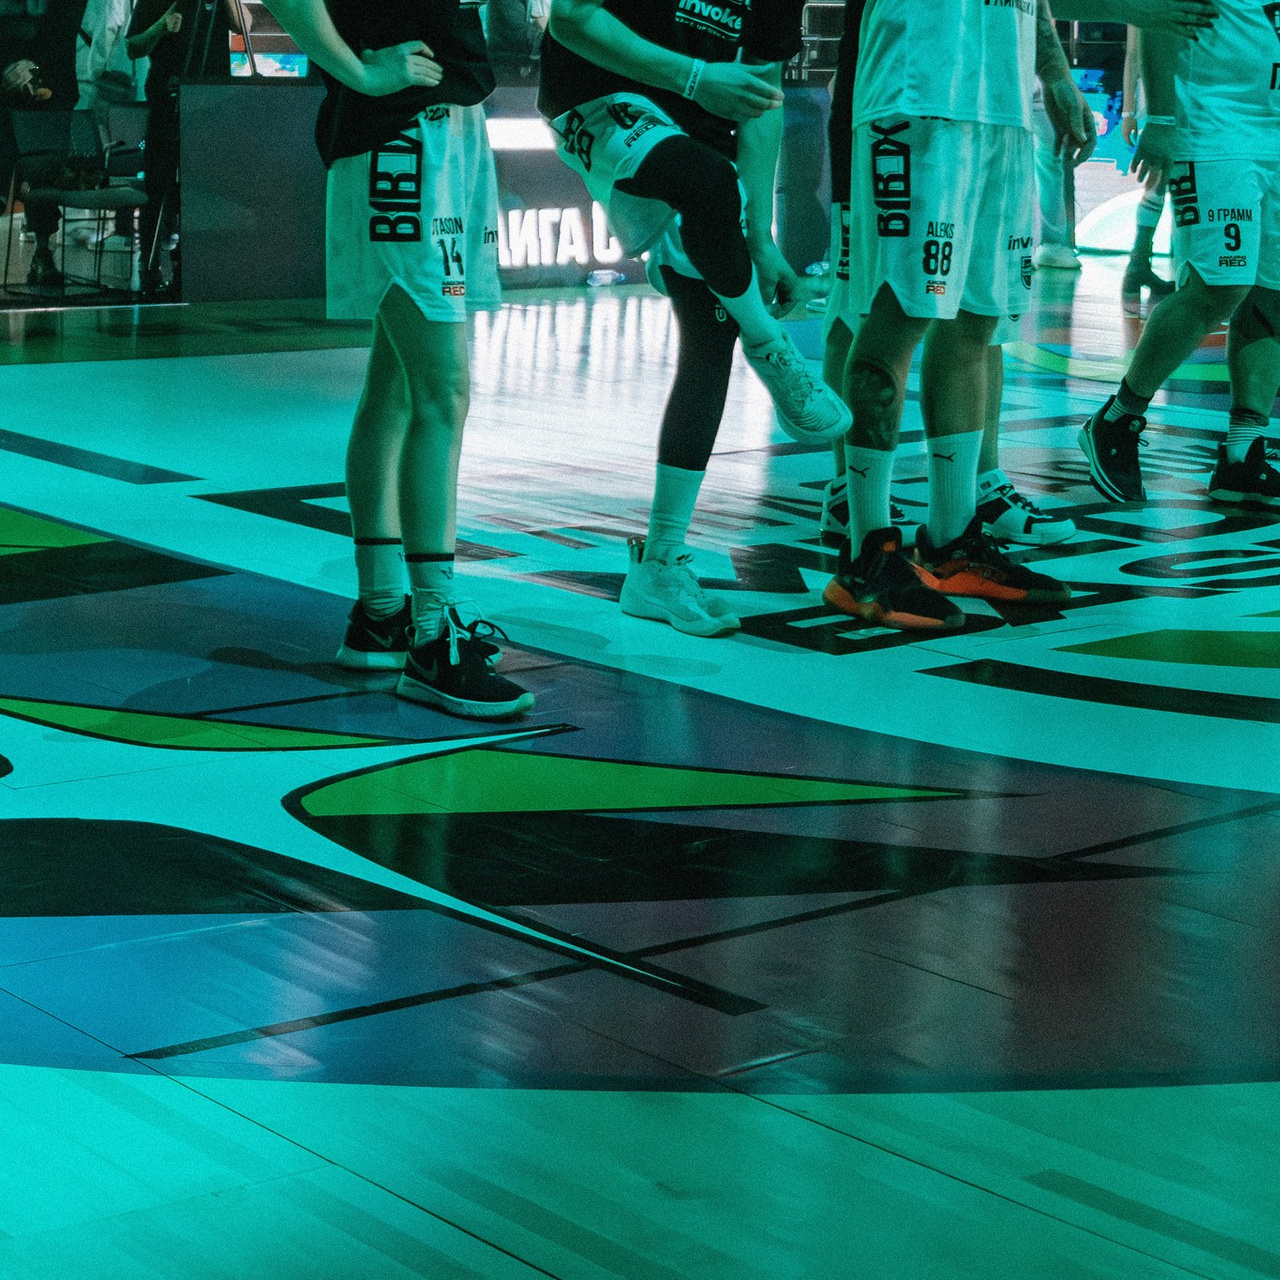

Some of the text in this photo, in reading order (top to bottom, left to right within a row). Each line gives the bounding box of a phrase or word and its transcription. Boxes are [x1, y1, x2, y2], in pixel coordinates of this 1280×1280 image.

[1207, 207, 1254, 223] 9 ГРАММ
[925, 220, 955, 239] ALEKS
[1223, 222, 1242, 253] 9
[436, 237, 464, 277] 14
[922, 239, 954, 277] 88
[1218, 260, 1247, 268] RED
[925, 285, 947, 296] RED
